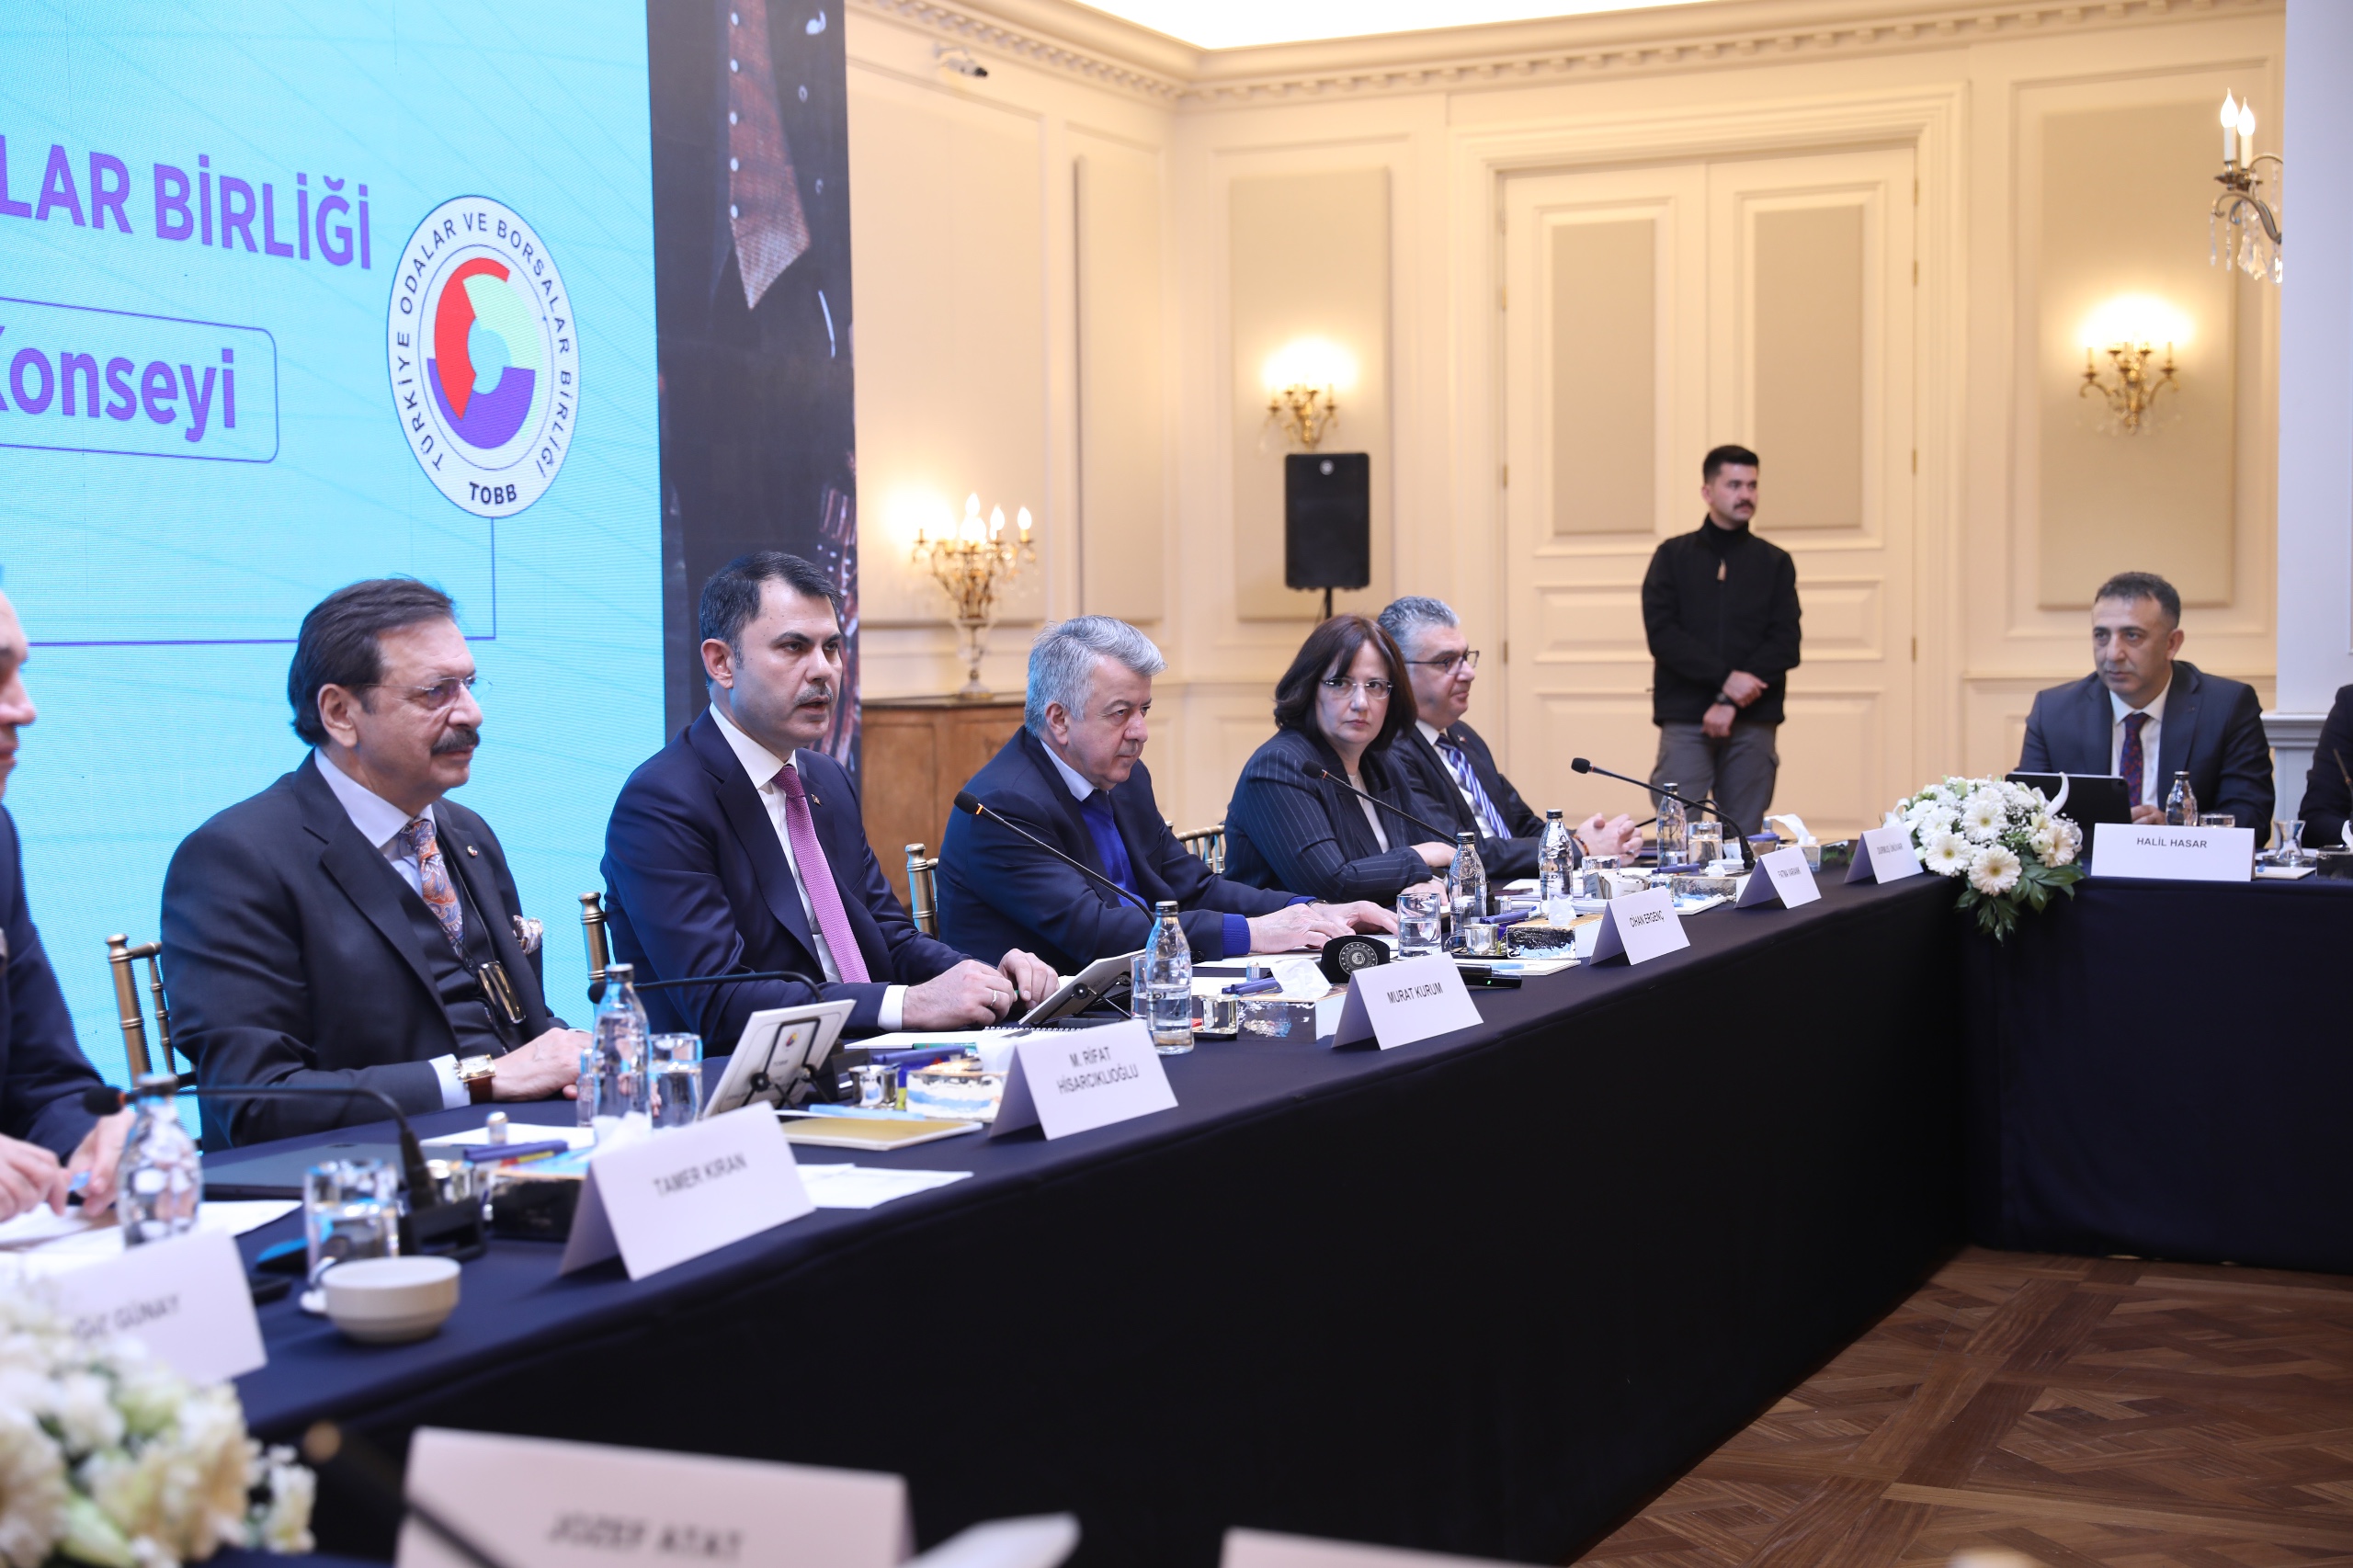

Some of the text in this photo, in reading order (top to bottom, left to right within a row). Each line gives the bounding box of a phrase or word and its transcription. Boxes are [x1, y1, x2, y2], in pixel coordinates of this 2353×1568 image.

[0, 135, 370, 270] LAR BİRLİĞİ
[400, 219, 457, 315] ODALAR
[463, 212, 487, 232] VE
[497, 220, 570, 354] BORSALAR
[0, 325, 235, 443] onseyi
[469, 481, 517, 505] TOBB
[2137, 836, 2207, 847] HALİL HASAR
[1630, 915, 1644, 926] CİHAN
[1387, 982, 1444, 1004] MURAT KURUM
[1082, 1046, 1111, 1065] RİFAT
[1056, 1062, 1139, 1095] HİSARCIKLIOĞLU
[653, 1153, 746, 1196] TAMER KIRAN
